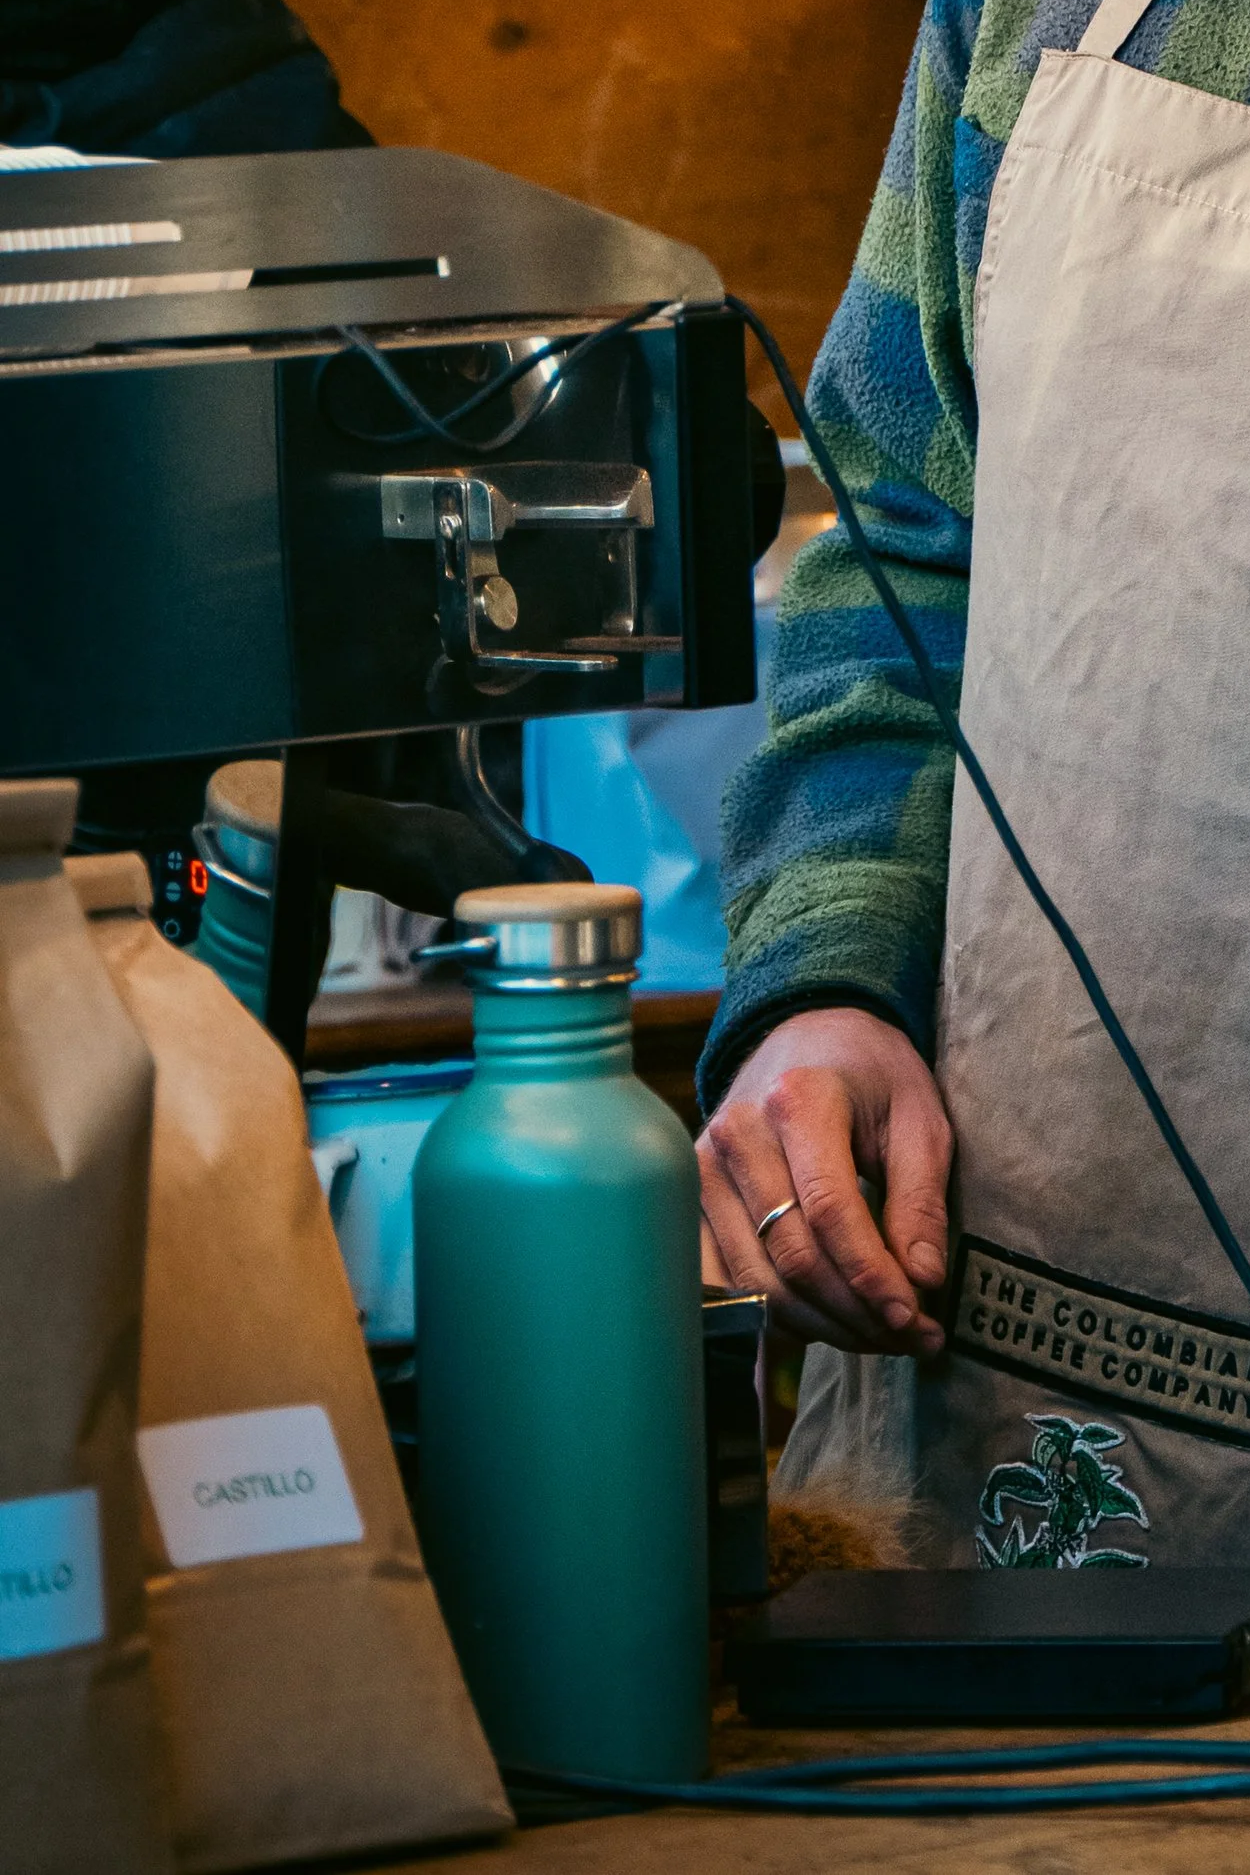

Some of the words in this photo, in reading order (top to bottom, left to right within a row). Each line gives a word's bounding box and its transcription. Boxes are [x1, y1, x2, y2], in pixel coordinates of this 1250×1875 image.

[978, 1271, 1036, 1314] THE
[969, 1308, 1087, 1371] COFFEE
[193, 1467, 315, 1509] CASTILLO
